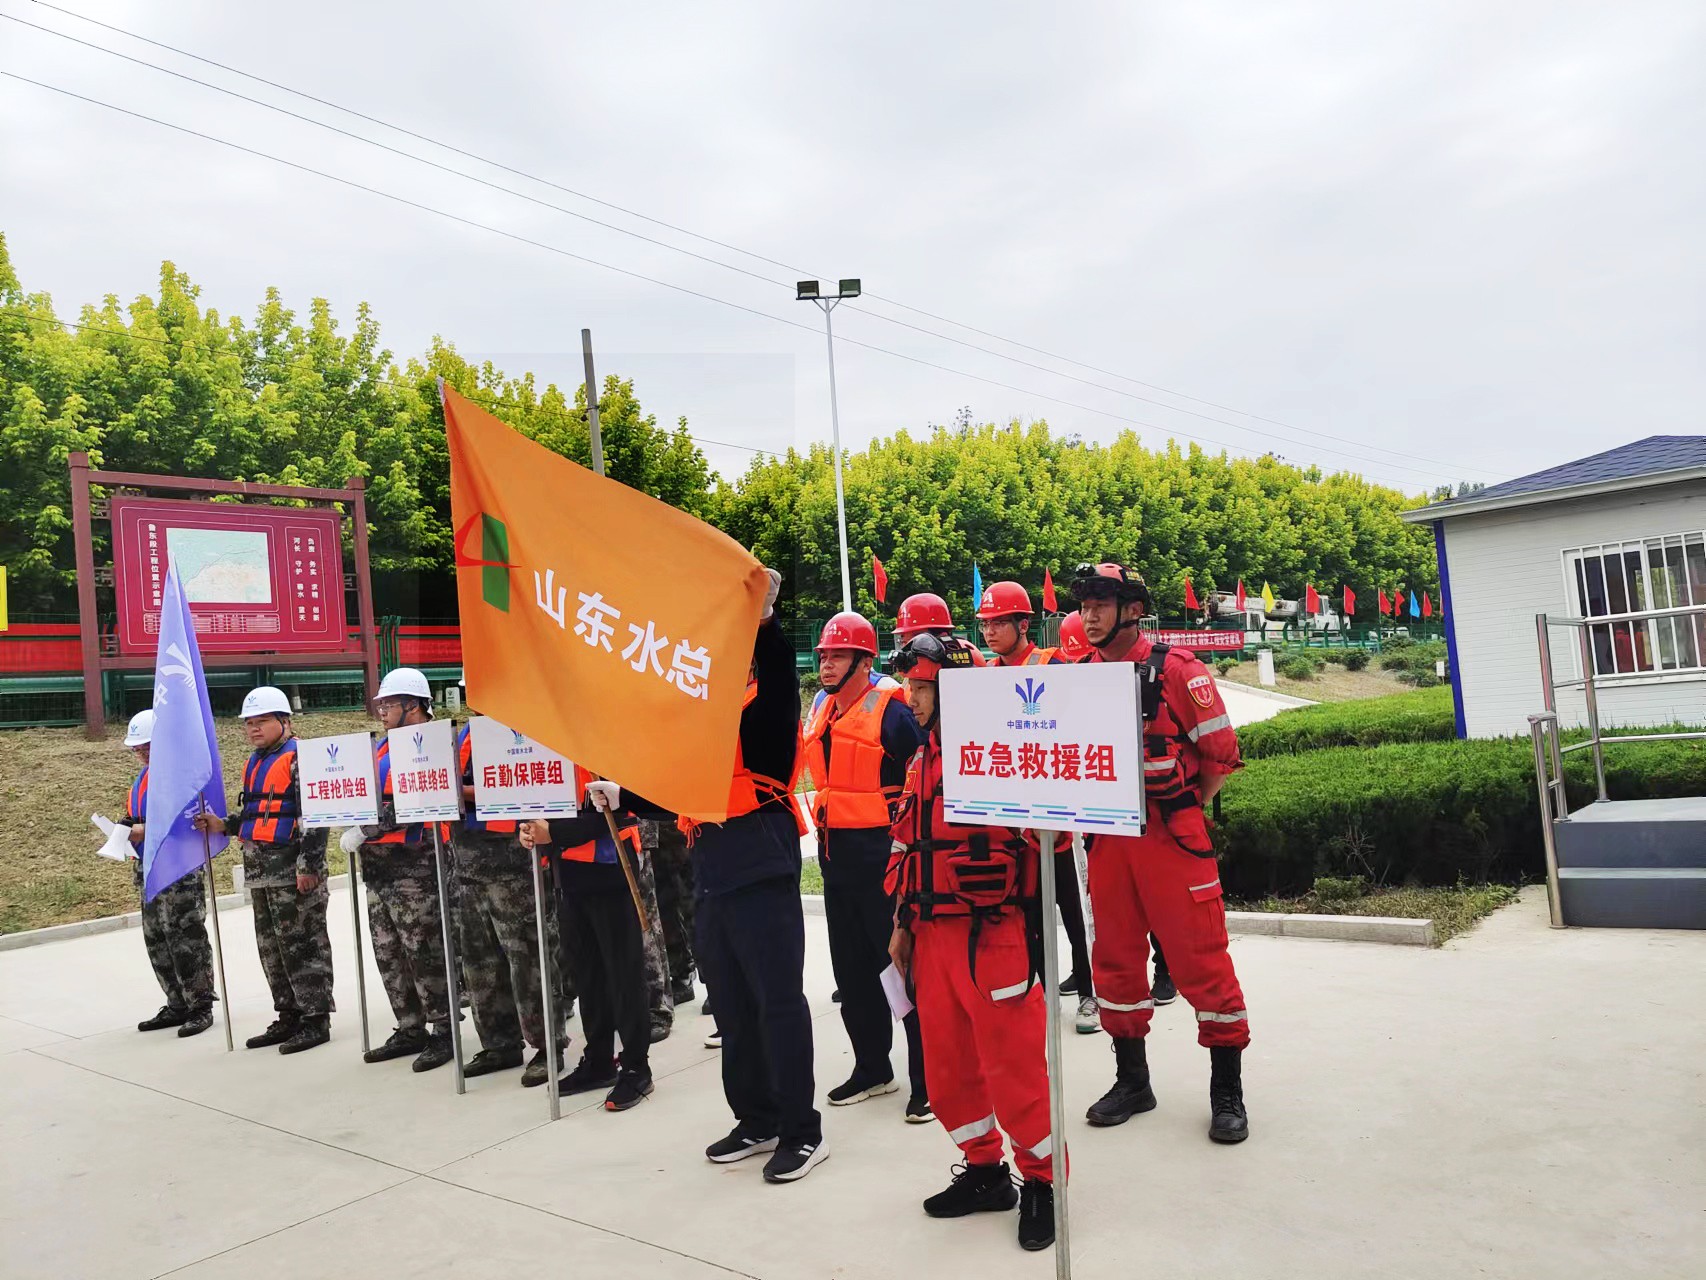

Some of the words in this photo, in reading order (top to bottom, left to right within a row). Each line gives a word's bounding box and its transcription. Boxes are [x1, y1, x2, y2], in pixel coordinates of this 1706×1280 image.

[534, 569, 711, 700] 山东水总
[1007, 719, 1057, 730] 中国南水北调
[483, 760, 565, 789] 后勤保障组
[958, 741, 1118, 782] 应急救援组
[307, 777, 368, 800] 工程抢险组
[397, 768, 450, 794] 通讯联络组
